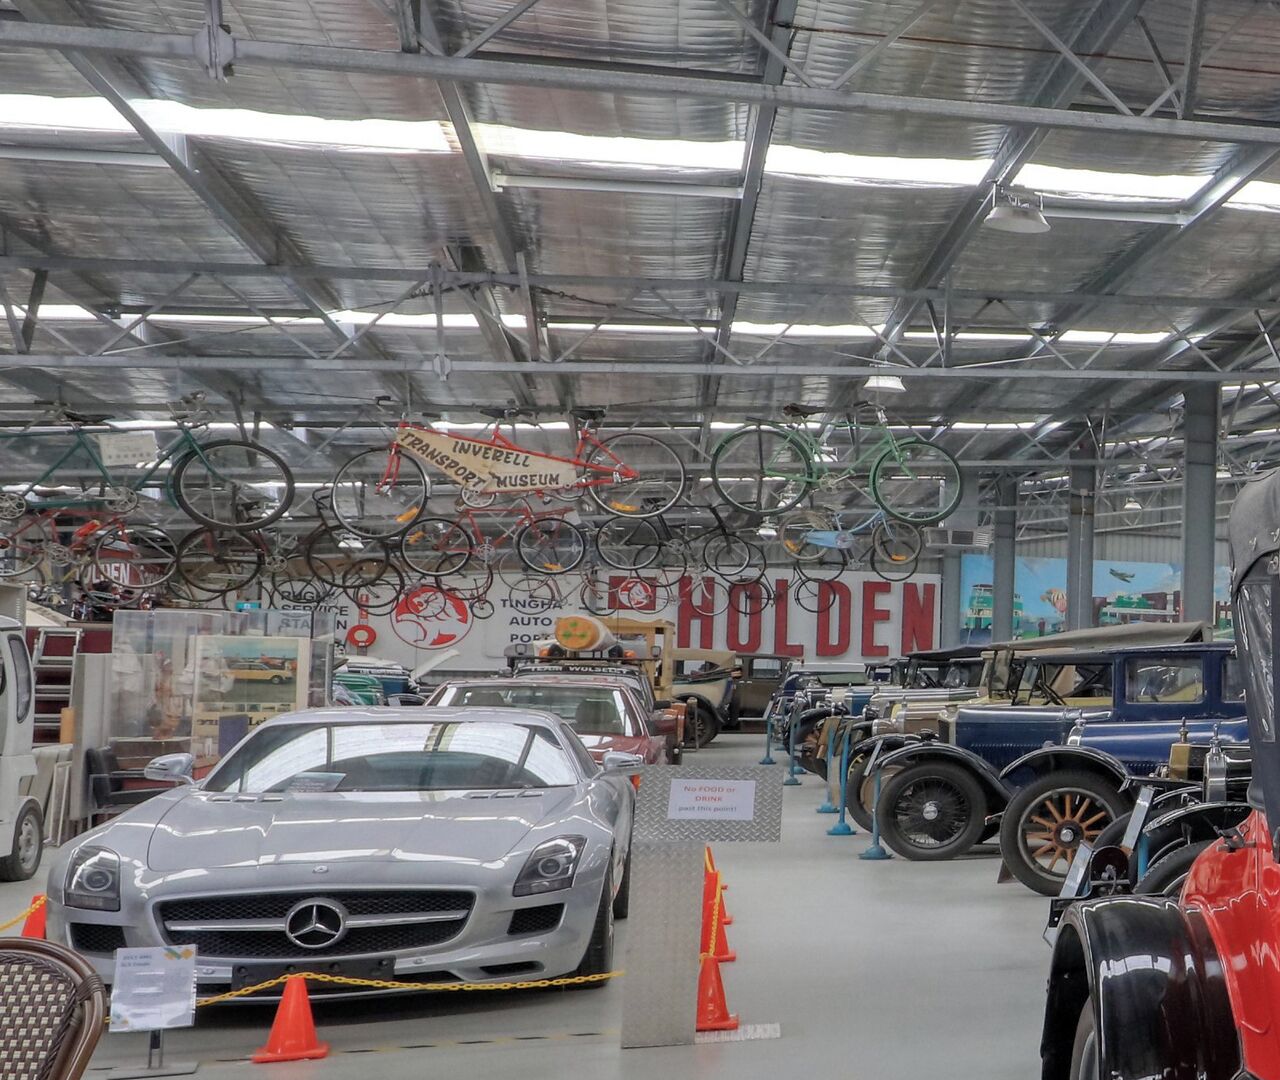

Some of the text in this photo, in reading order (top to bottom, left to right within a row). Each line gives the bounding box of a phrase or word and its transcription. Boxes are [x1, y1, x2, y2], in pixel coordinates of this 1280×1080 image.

[401, 432, 486, 489] TRANSPORT
[452, 440, 530, 468] INVERELL
[496, 473, 560, 488] MUSEUM
[501, 598, 562, 610] TINGHA
[509, 616, 553, 626] AUTO
[677, 575, 936, 657] HOLDEN
[281, 618, 347, 630] STAN
[683, 785, 697, 793] No
[698, 785, 725, 793] FOOD
